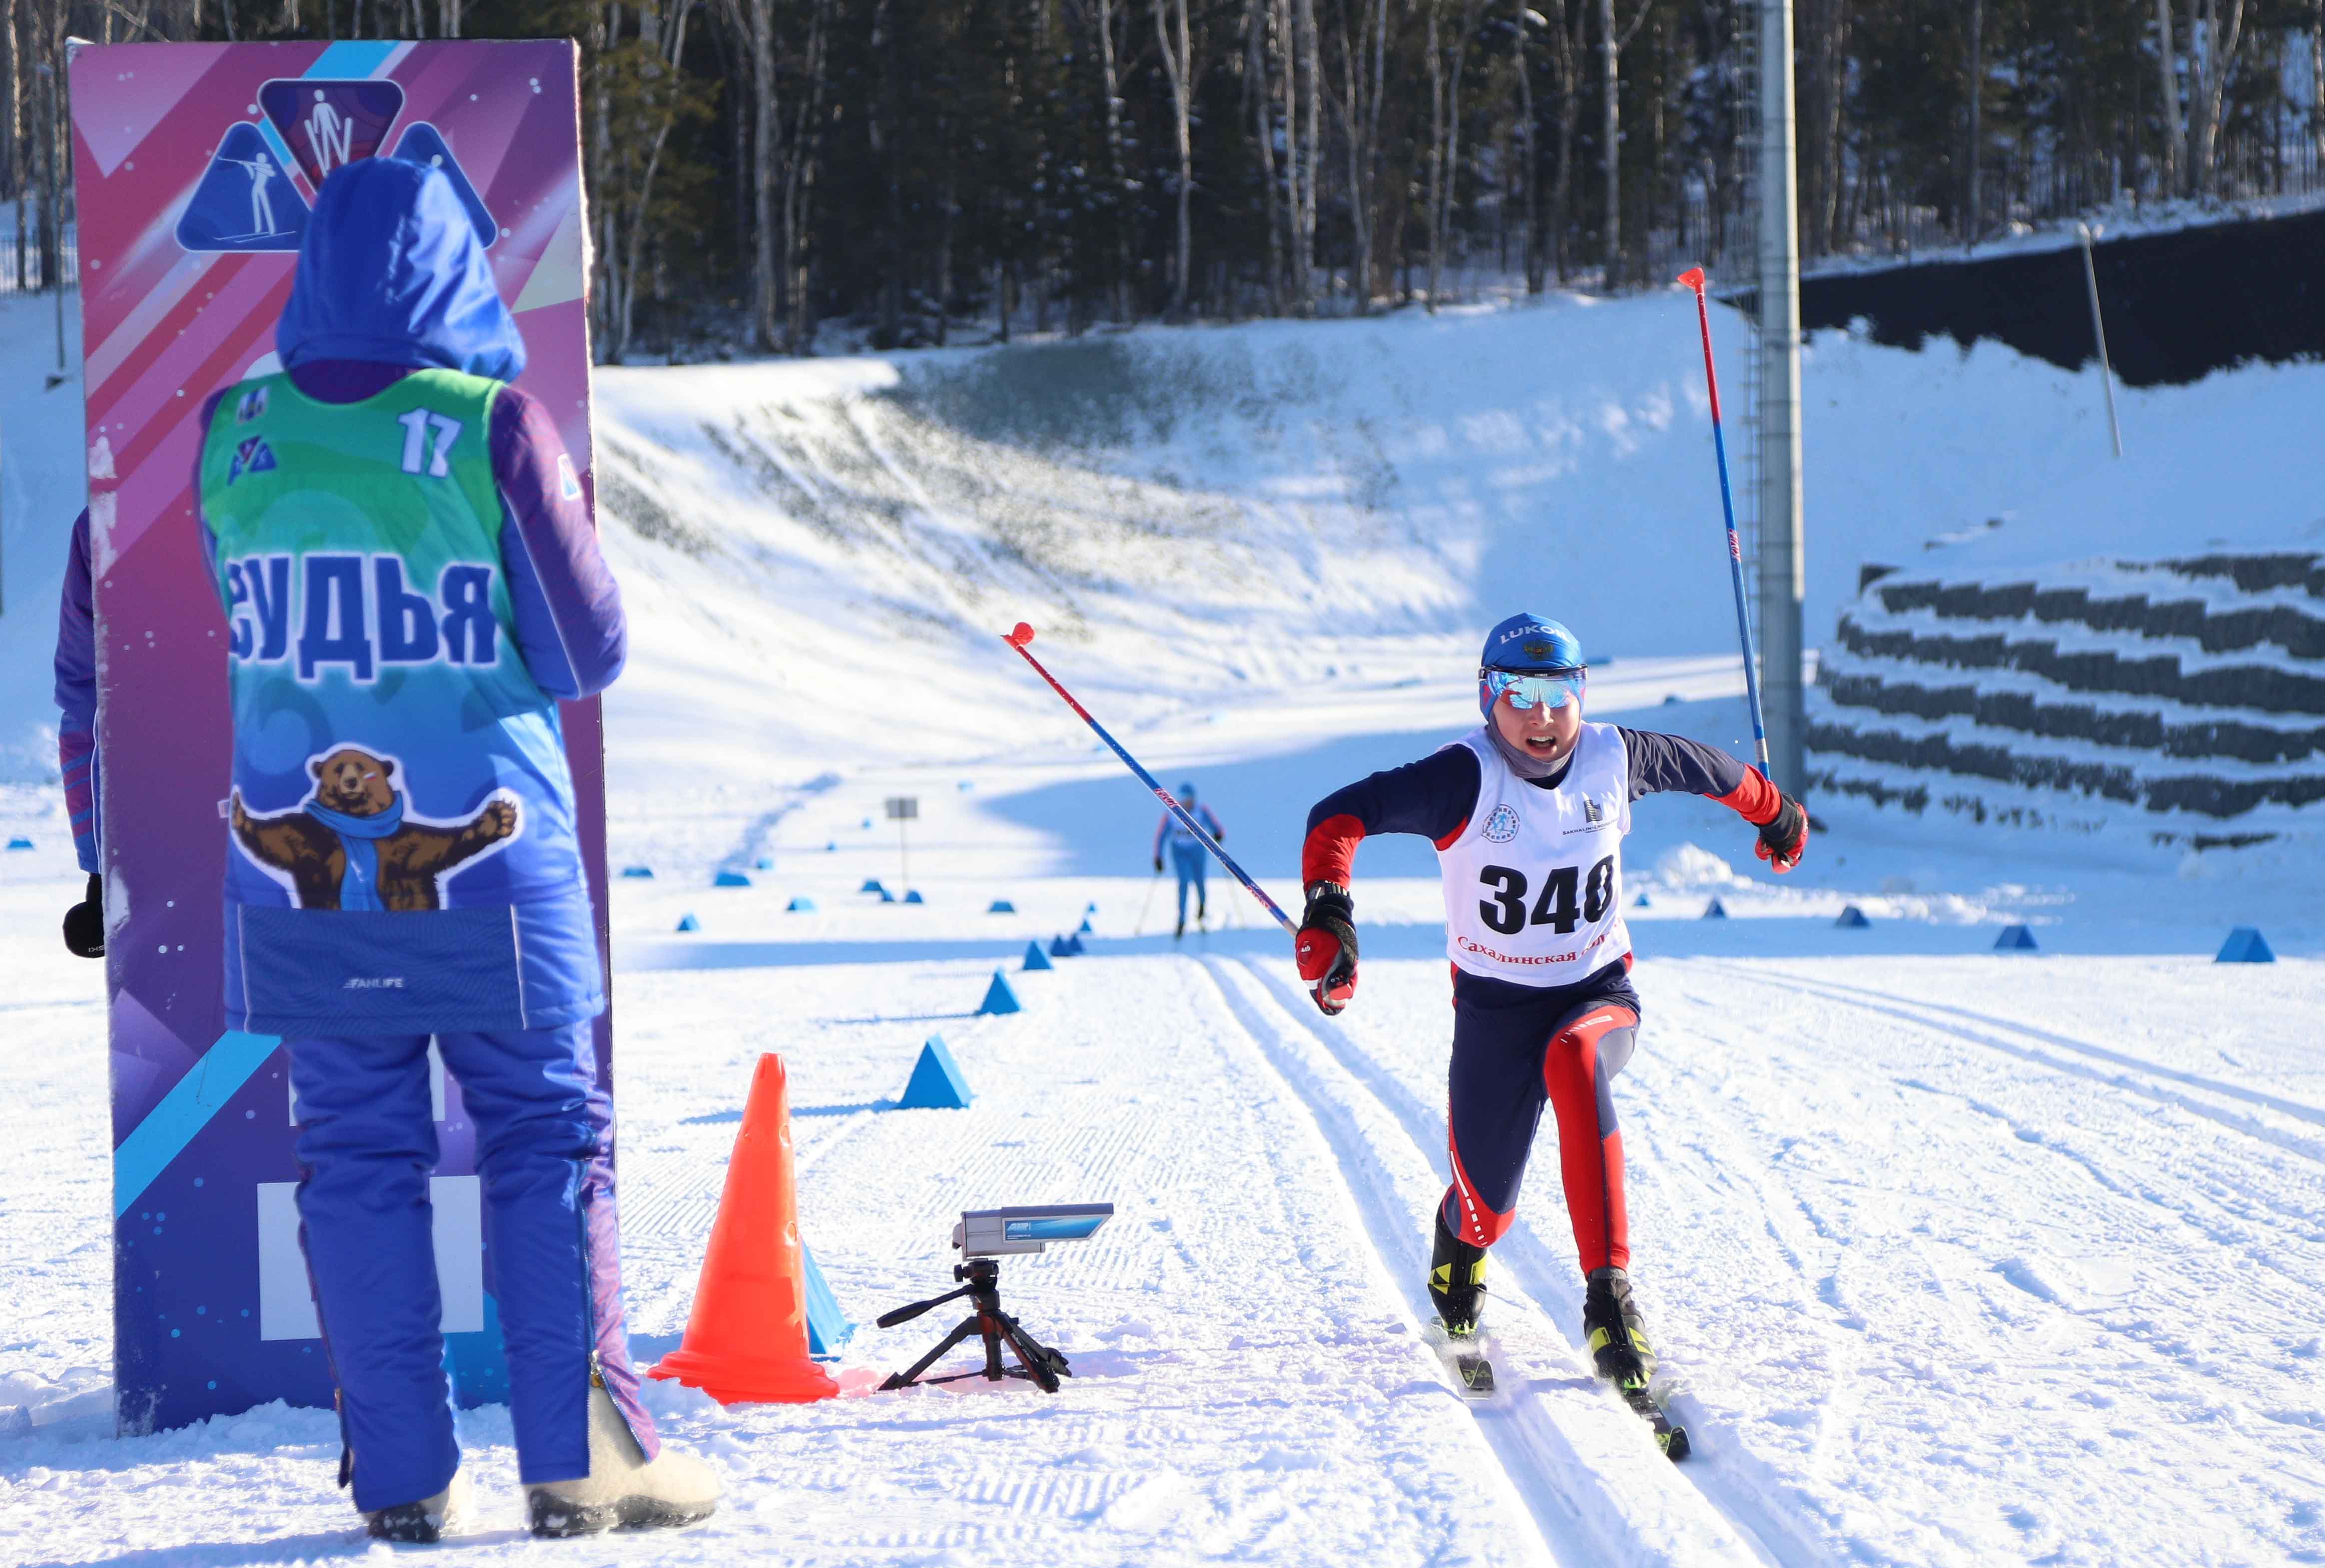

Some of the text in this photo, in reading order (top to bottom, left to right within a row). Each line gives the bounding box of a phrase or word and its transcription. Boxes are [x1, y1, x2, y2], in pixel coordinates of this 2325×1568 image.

[397, 406, 463, 479] 17
[1479, 854, 1614, 935] 340
[1458, 936, 1576, 965] Сахалинская
